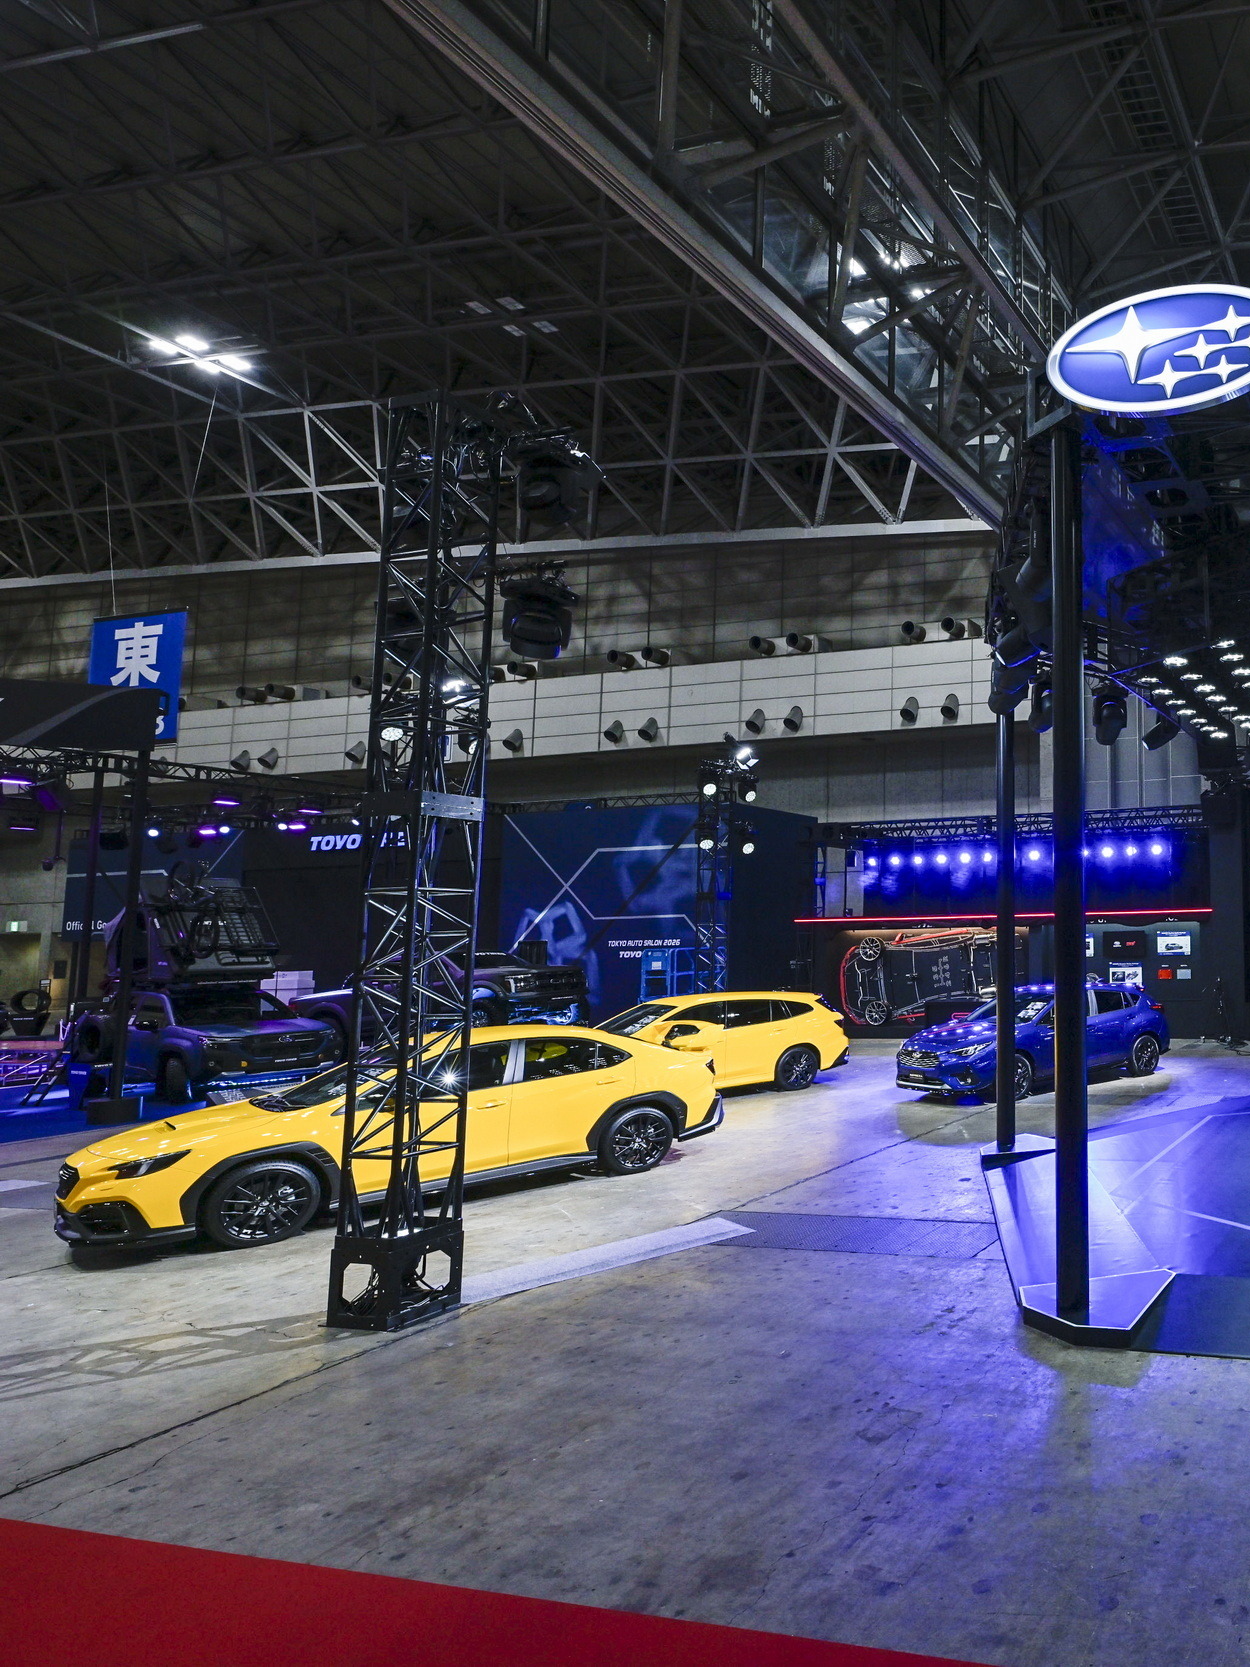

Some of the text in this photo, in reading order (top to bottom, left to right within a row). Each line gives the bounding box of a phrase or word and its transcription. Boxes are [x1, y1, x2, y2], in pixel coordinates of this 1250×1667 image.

[110, 622, 164, 687] 東
[310, 834, 362, 851] TOYO
[66, 921, 94, 931] Officl
